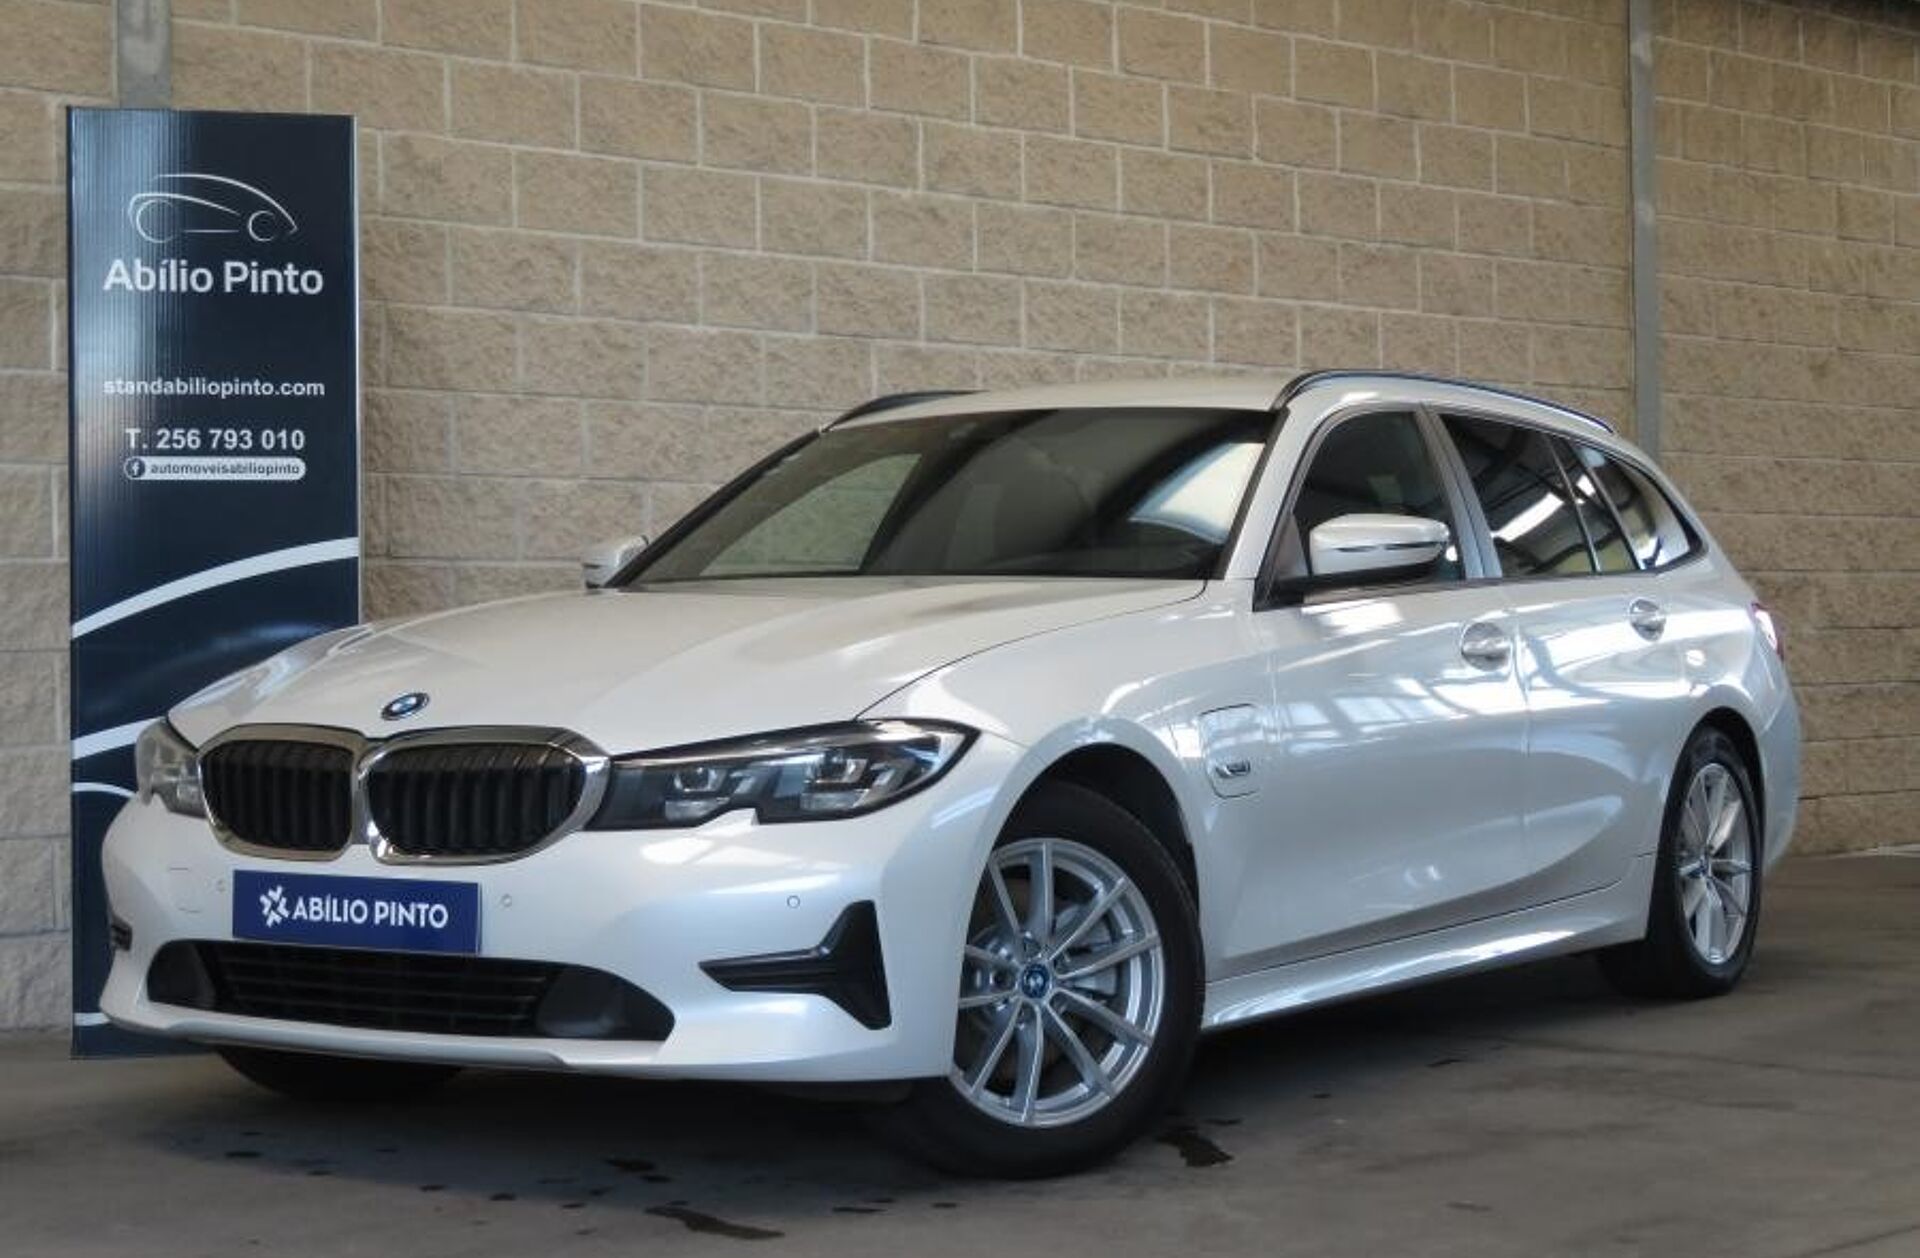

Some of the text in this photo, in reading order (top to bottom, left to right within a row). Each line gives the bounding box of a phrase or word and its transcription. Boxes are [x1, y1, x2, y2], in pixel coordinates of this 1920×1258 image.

[103, 258, 324, 295] Abílio Pinto
[102, 377, 326, 399] standabiliopinto.com
[125, 428, 305, 450] T. 256 793 010
[150, 461, 300, 476] automoveisabiliopinto
[292, 893, 449, 929] ABÍLIO PINTO
